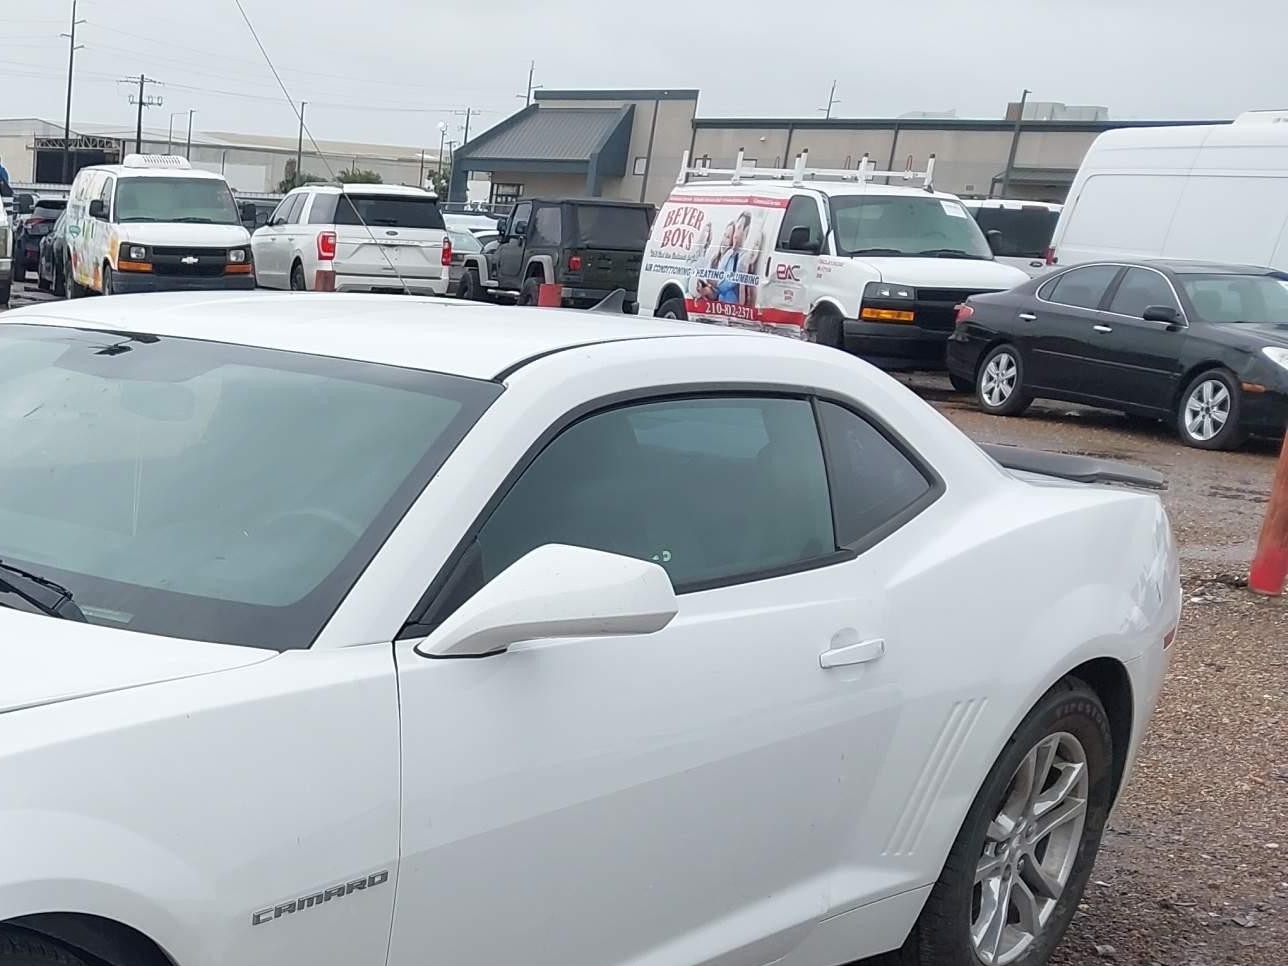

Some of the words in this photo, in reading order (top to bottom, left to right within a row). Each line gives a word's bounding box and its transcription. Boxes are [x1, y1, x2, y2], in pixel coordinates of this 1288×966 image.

[663, 206, 705, 231] BEYER
[661, 227, 695, 250] BOYS
[653, 264, 691, 276] CONDITIONING
[695, 269, 724, 280] HEATING
[729, 273, 760, 285] PLUMBING
[252, 869, 389, 926] CAMARO
